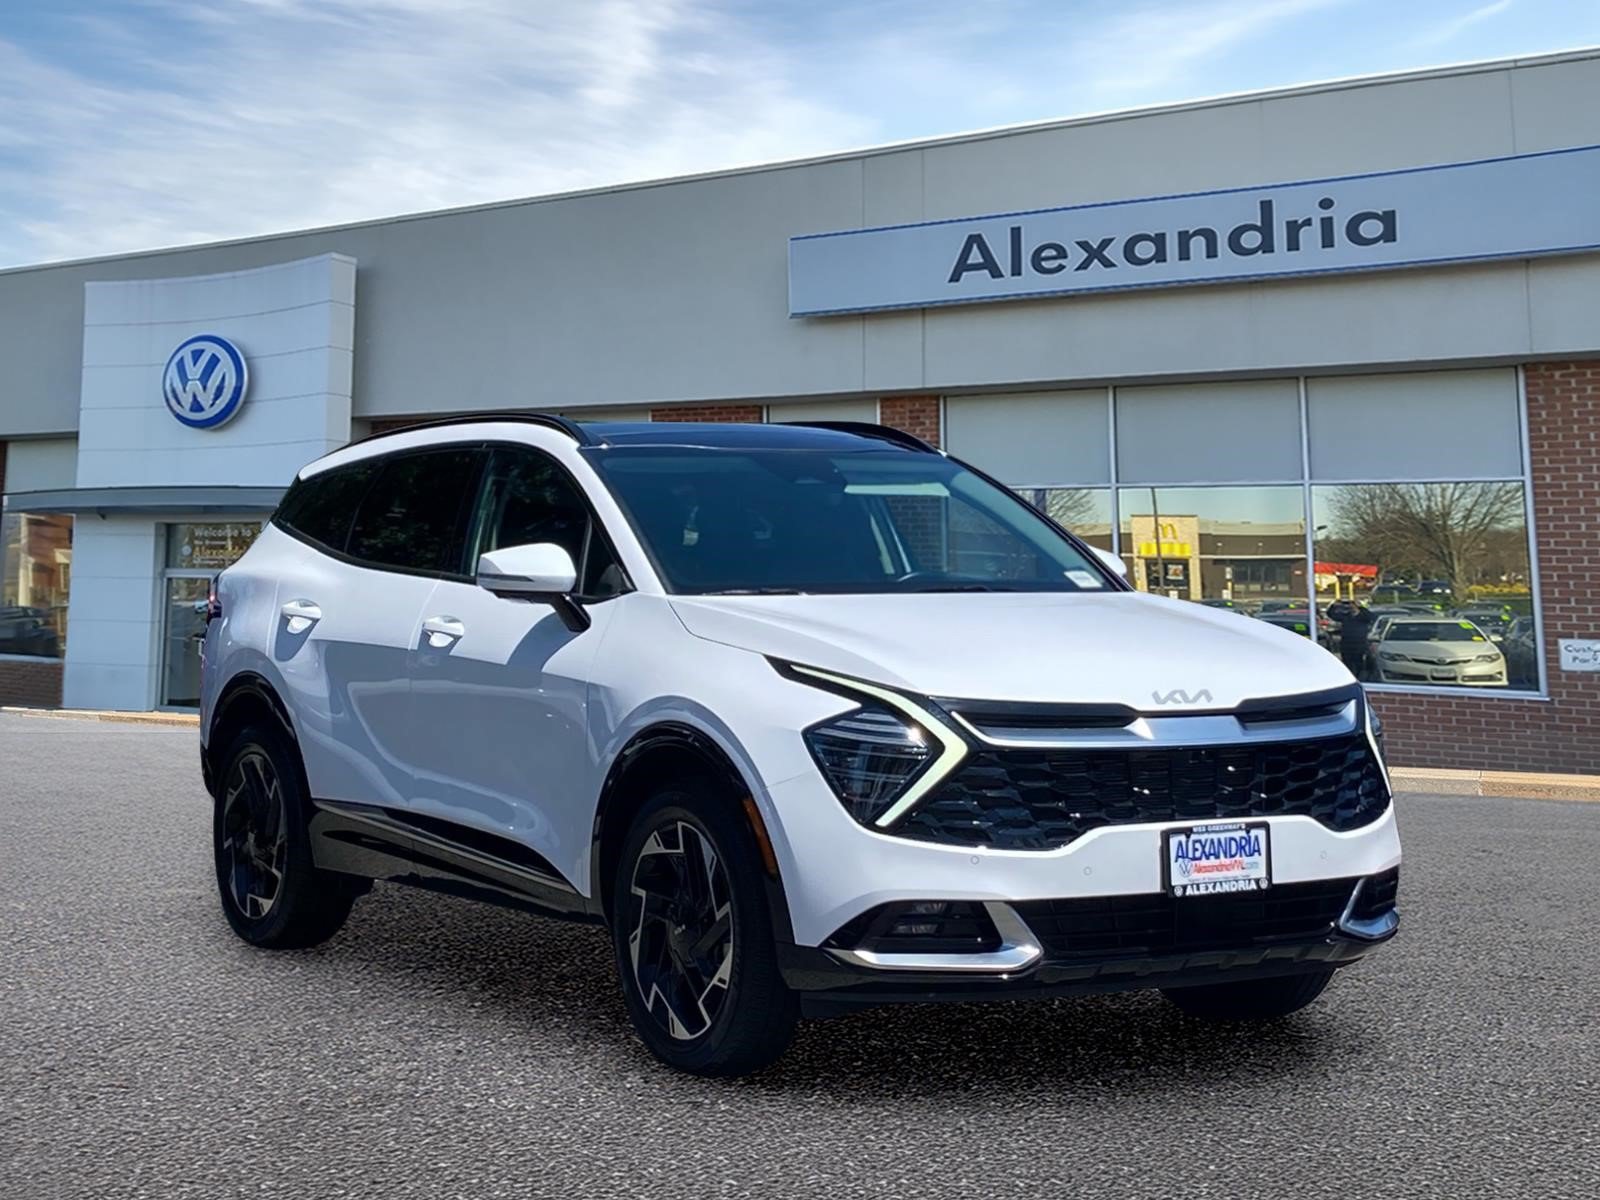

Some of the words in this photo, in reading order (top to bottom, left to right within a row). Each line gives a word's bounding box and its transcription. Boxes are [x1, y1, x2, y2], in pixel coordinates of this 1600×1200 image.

[948, 197, 1397, 284] Alexandria
[194, 527, 239, 537] Welcome
[241, 527, 252, 537] to
[1175, 835, 1262, 863] ALEXANDRIA
[1186, 881, 1257, 895] ALEXANDRIA
